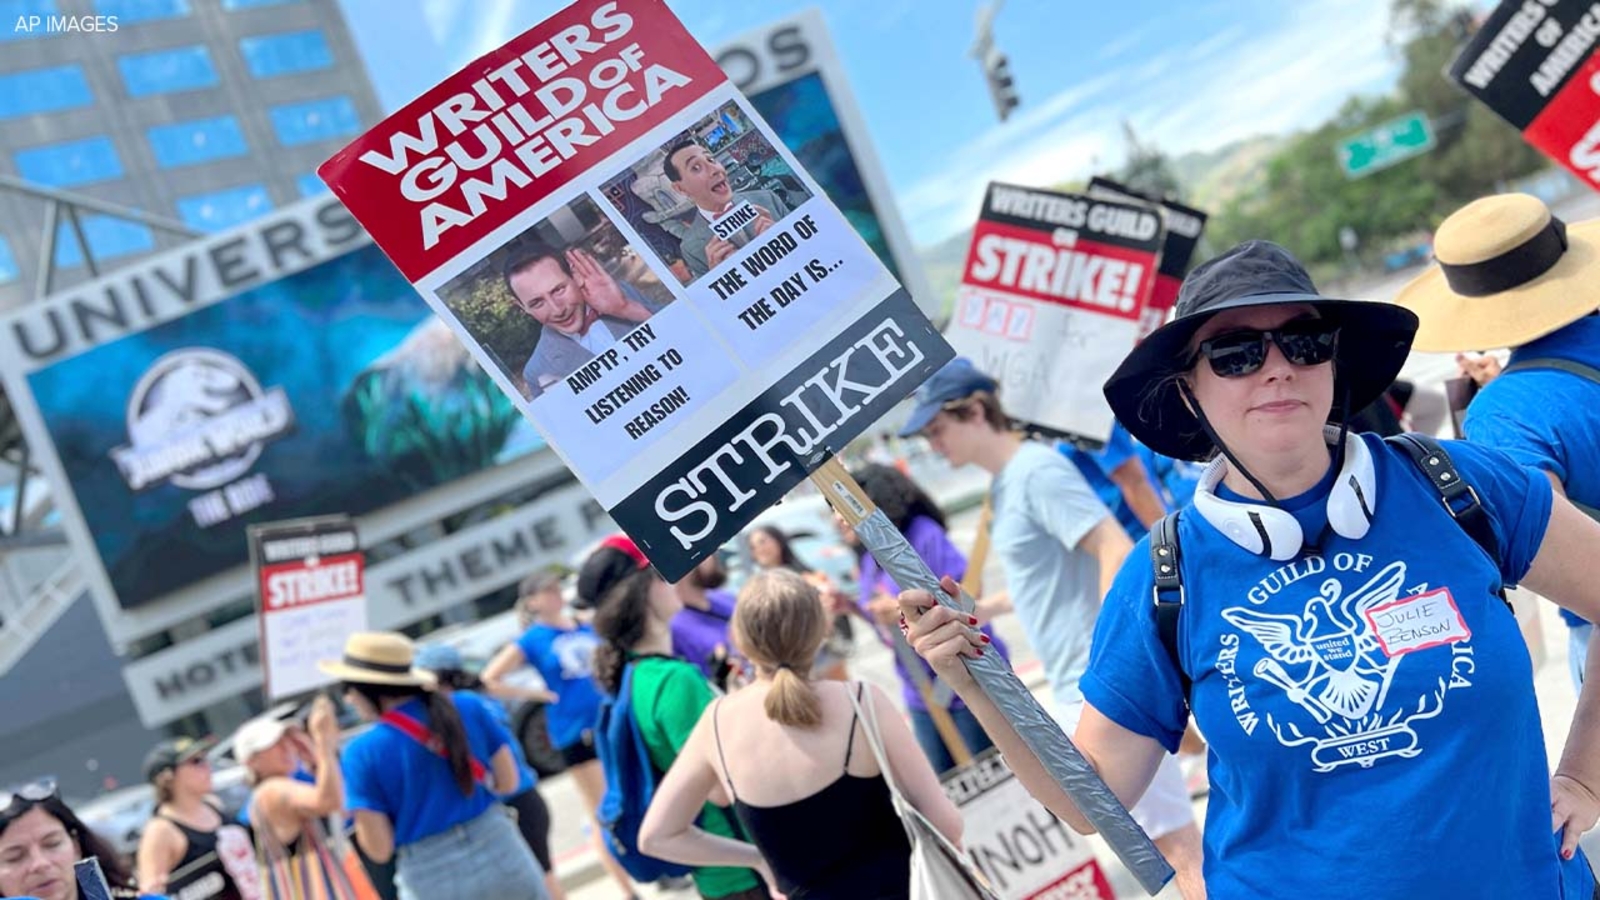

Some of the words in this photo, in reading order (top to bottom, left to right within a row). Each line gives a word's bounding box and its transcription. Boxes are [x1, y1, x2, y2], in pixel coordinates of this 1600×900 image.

[1463, 1, 1546, 89] WRITERS
[1535, 17, 1563, 47] OF
[358, 1, 633, 175] WRITERS
[400, 77, 587, 200] GUILD
[588, 42, 645, 89] OF
[420, 63, 692, 251] AMERICA
[713, 203, 757, 239] STRIKE
[991, 187, 1088, 228] WRITERS
[1087, 203, 1158, 241] GUILD
[11, 201, 362, 359] UNIVERS
[708, 267, 748, 301] THE
[741, 230, 799, 278] WORD
[797, 214, 819, 241] OF
[971, 233, 1143, 313] STRIKE!
[737, 297, 777, 331] THE
[769, 272, 809, 308] DAY
[804, 258, 844, 283] IS...
[623, 323, 657, 353] TRY
[584, 364, 663, 425] LISTENING
[657, 348, 684, 371] TO
[624, 385, 691, 440] REASON!
[654, 318, 925, 550] STRIKE
[268, 560, 359, 608] STRIKE!
[388, 516, 563, 606] THEME
[1248, 555, 1326, 604] GUILD
[1333, 553, 1373, 574] OF
[1376, 600, 1438, 628] JULIE
[1379, 619, 1451, 645] BENSON
[154, 641, 260, 698] HOTE
[1316, 637, 1350, 651] united
[1323, 650, 1353, 662] stand
[1338, 737, 1390, 759] WEST
[968, 806, 1075, 889] HON
